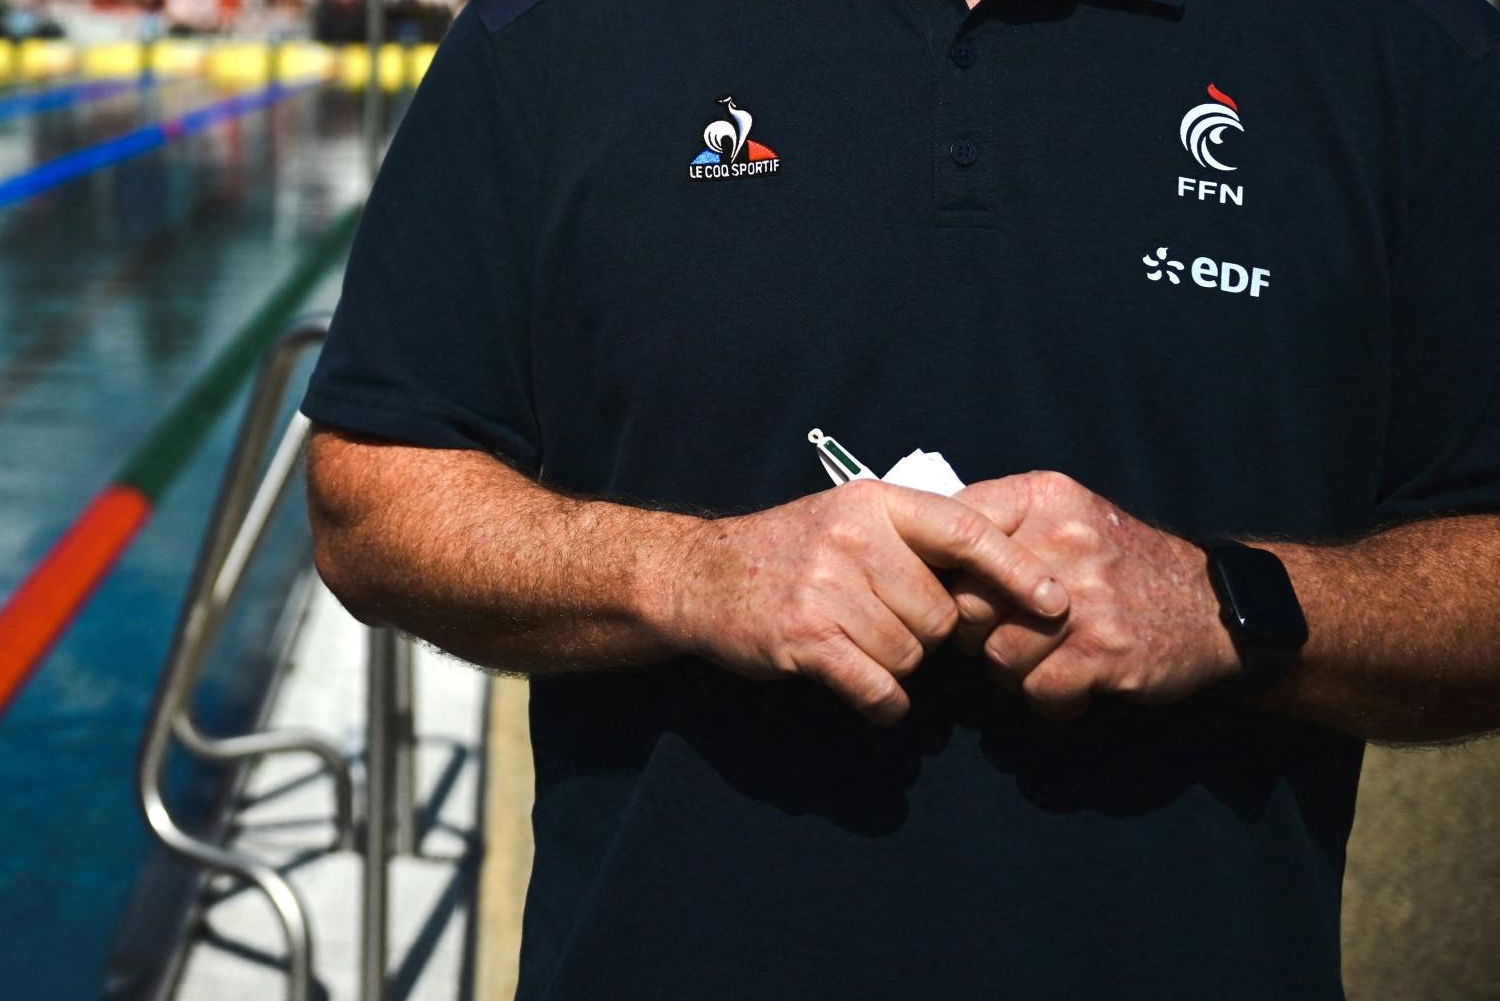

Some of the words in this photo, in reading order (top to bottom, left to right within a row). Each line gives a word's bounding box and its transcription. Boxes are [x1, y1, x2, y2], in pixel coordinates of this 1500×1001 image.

[690, 166, 703, 178] LE
[705, 165, 729, 178] COQ
[731, 159, 780, 176] SPORTIF
[1178, 176, 1244, 206] FFN
